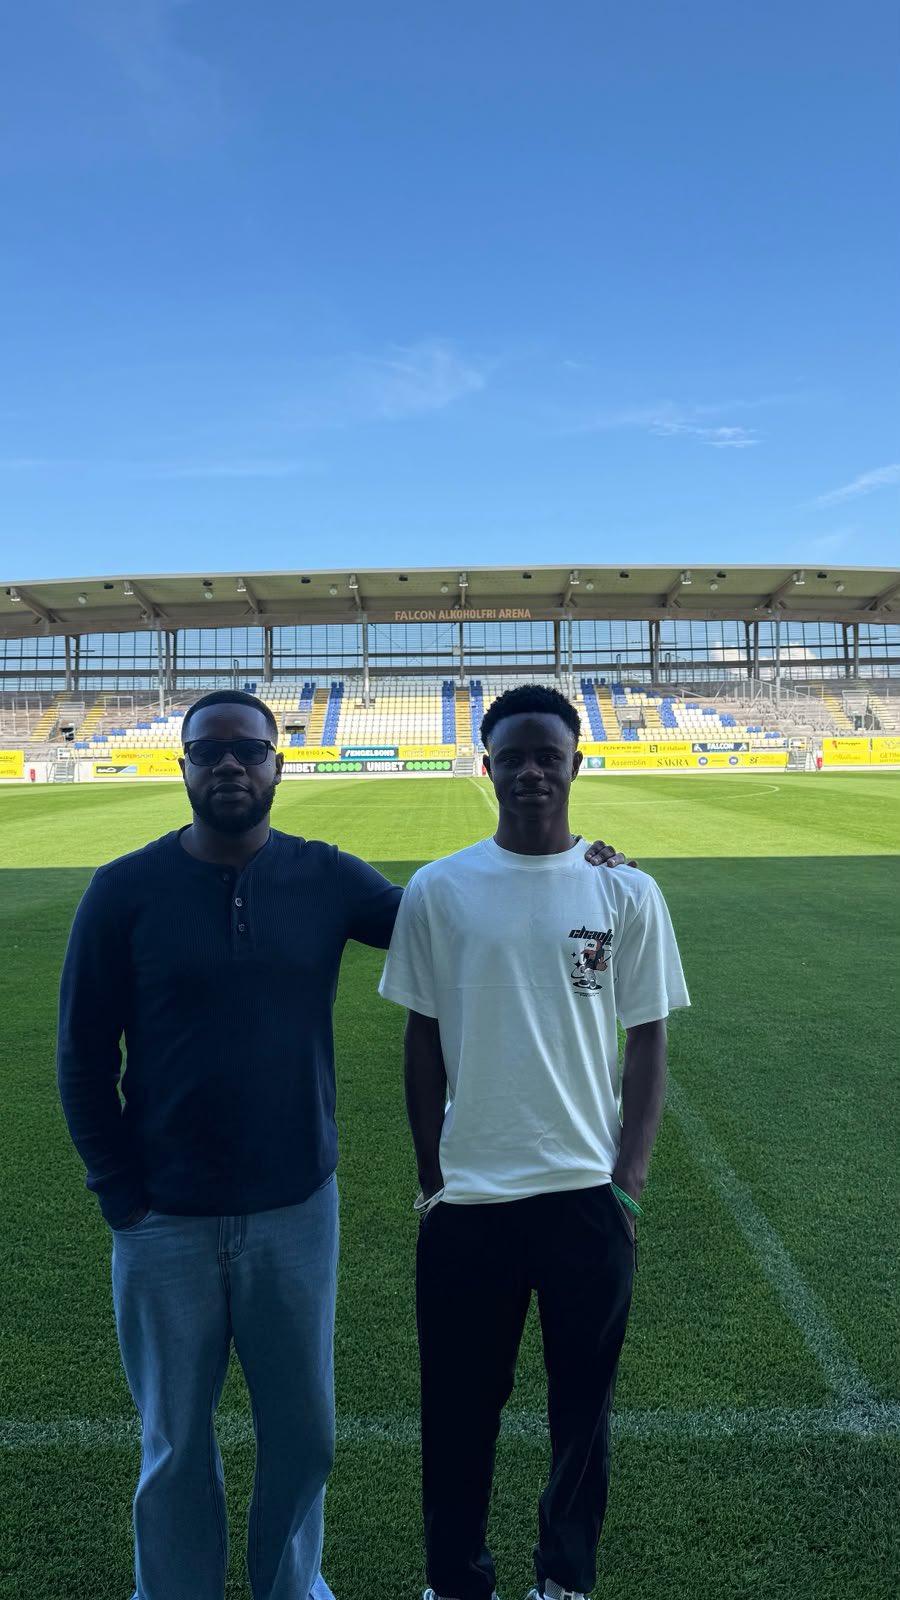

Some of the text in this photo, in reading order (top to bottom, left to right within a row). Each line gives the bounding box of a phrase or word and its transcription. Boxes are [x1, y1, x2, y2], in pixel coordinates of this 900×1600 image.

[394, 608, 532, 620] FALCON ALKOHOLFRI ARENA
[707, 742, 735, 750] FALCON
[366, 762, 405, 771] UNIBET
